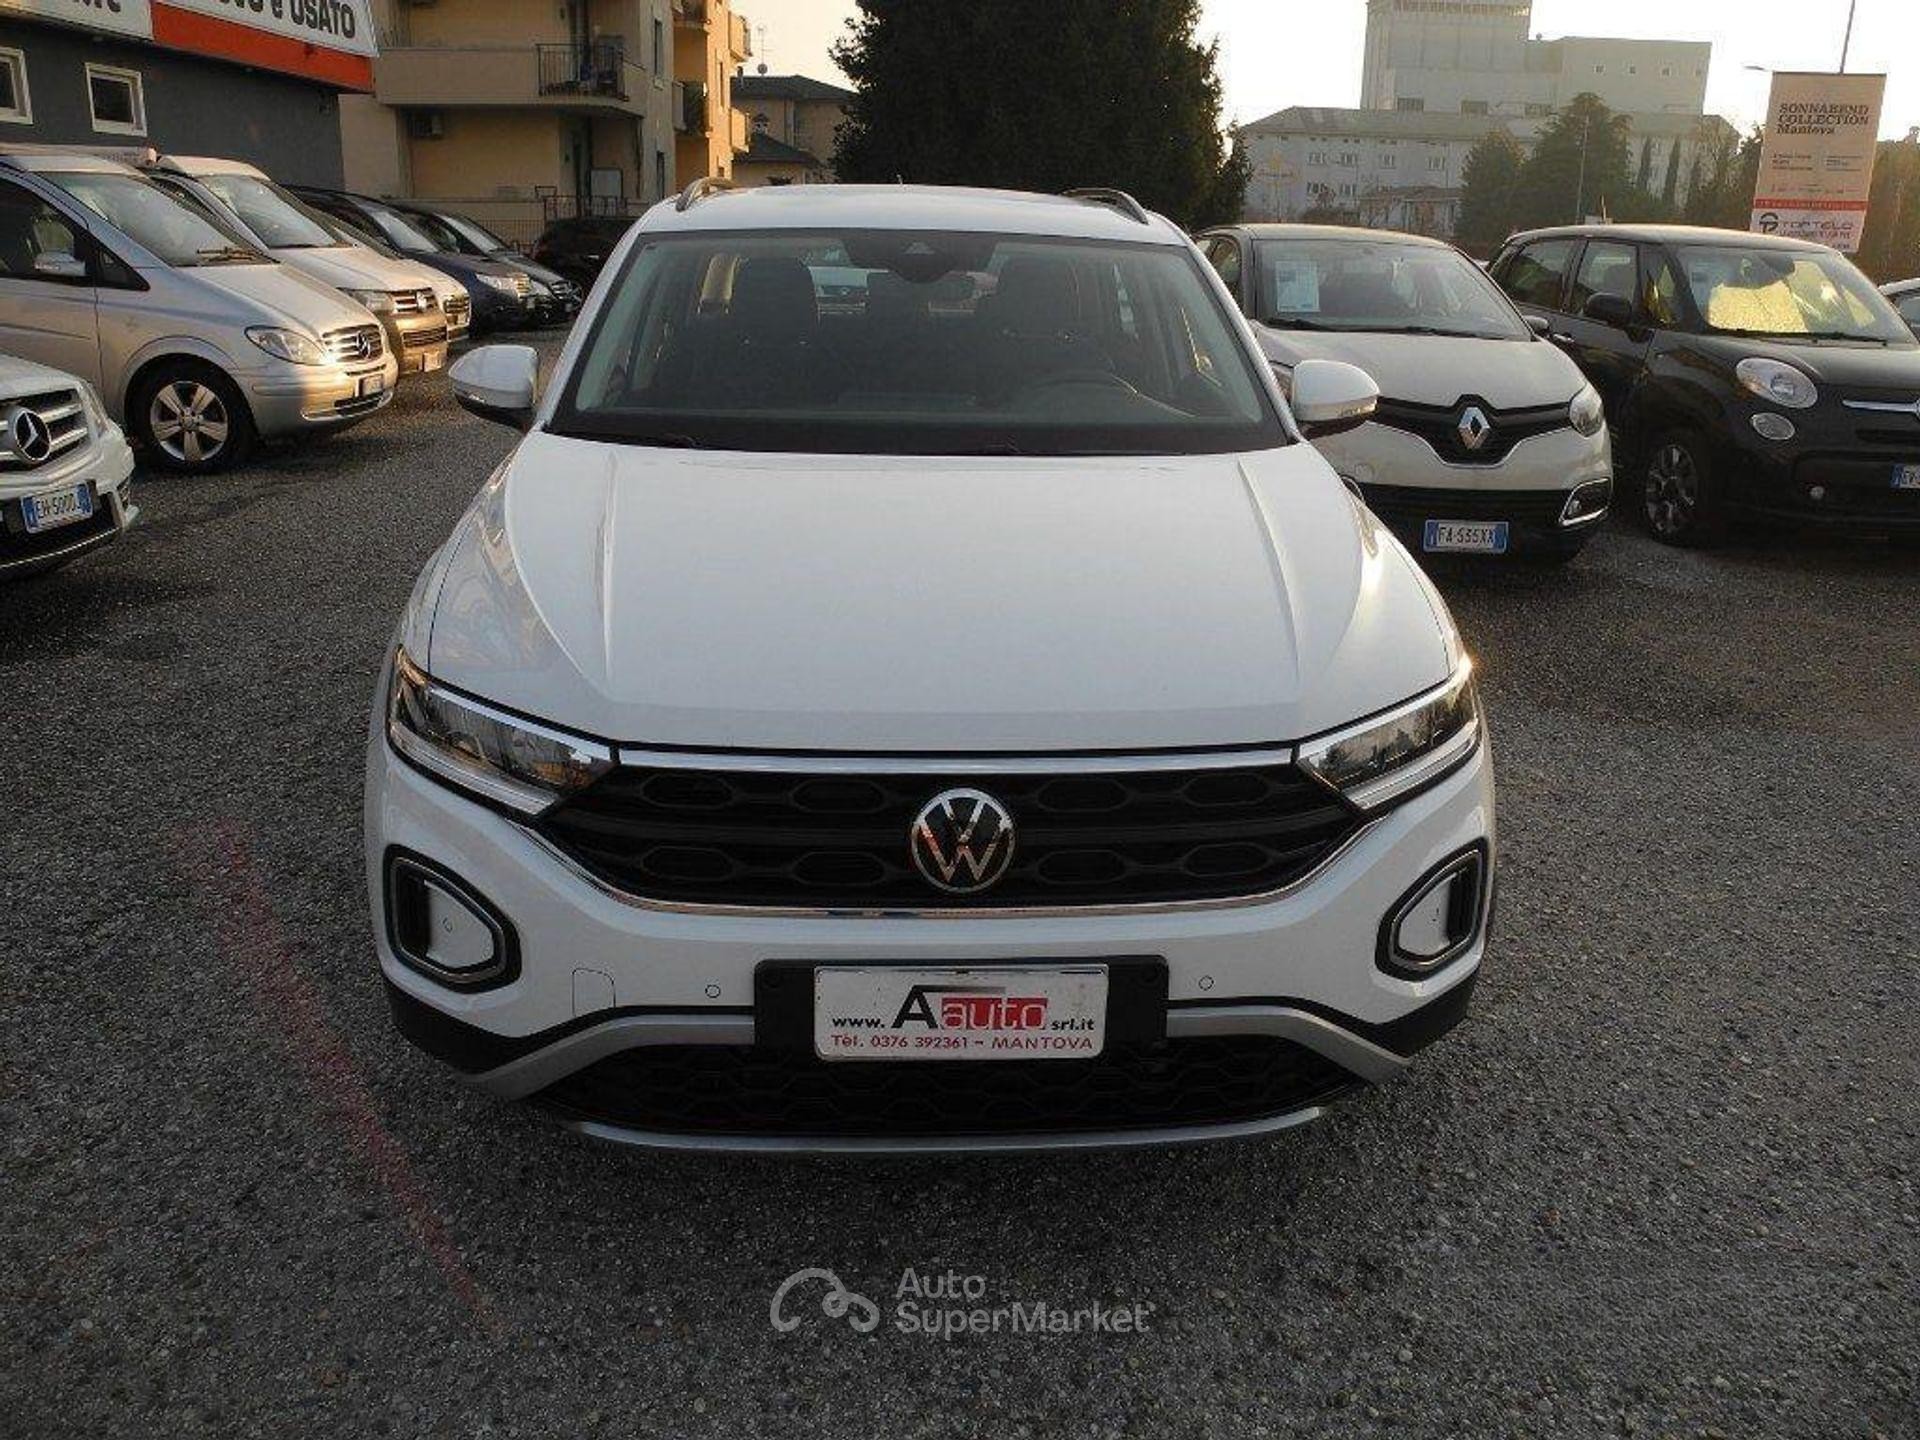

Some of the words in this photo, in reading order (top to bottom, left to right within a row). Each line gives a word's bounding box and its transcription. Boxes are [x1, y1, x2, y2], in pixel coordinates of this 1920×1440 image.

[290, 0, 356, 38] USATO
[1779, 103, 1869, 115] SONNABEND
[1778, 114, 1869, 125] COLLECTION
[832, 1015, 885, 1029] www.
[870, 1034, 908, 1048] 0376
[914, 1034, 968, 1049] 392361
[991, 1036, 1093, 1050] MANTOVA
